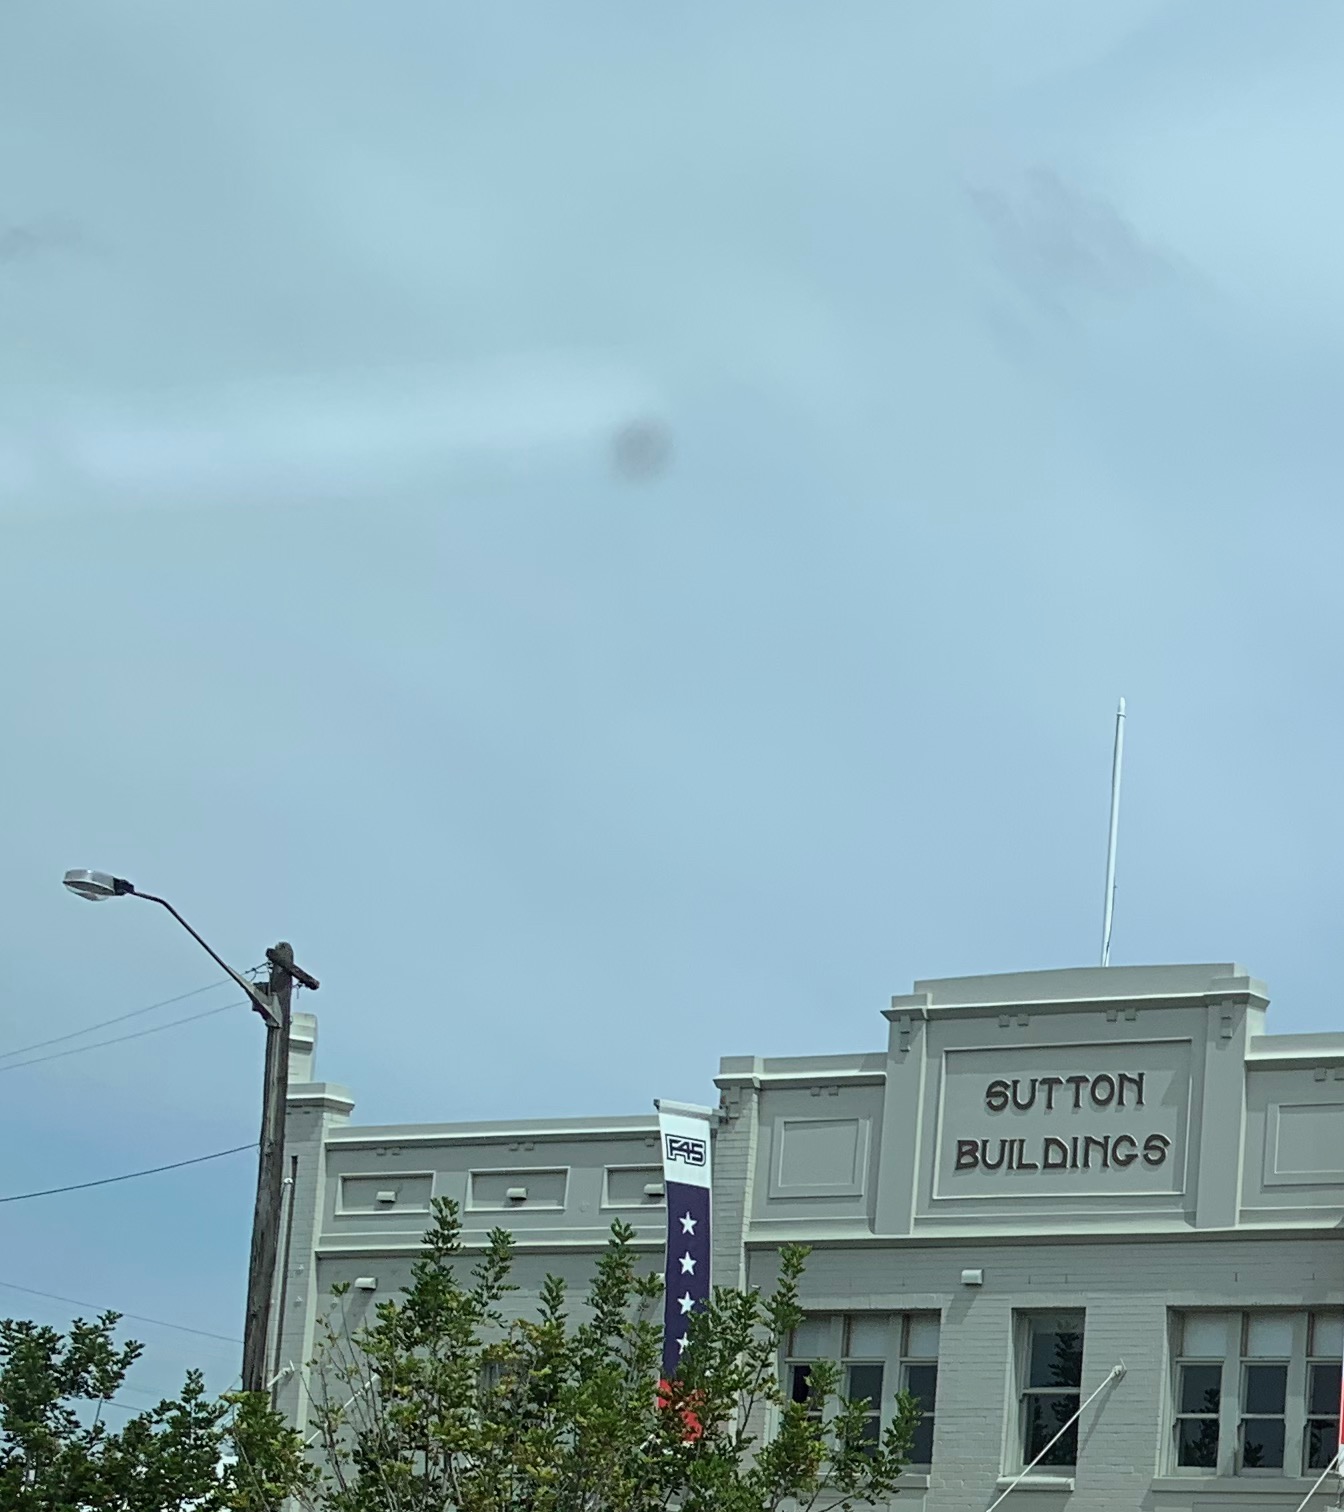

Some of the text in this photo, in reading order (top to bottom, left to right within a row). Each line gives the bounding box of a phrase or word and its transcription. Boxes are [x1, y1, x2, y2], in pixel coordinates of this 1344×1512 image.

[985, 1072, 1146, 1112] SUTTON
[665, 1134, 706, 1167] F45
[955, 1134, 1171, 1171] BUILDINGS
